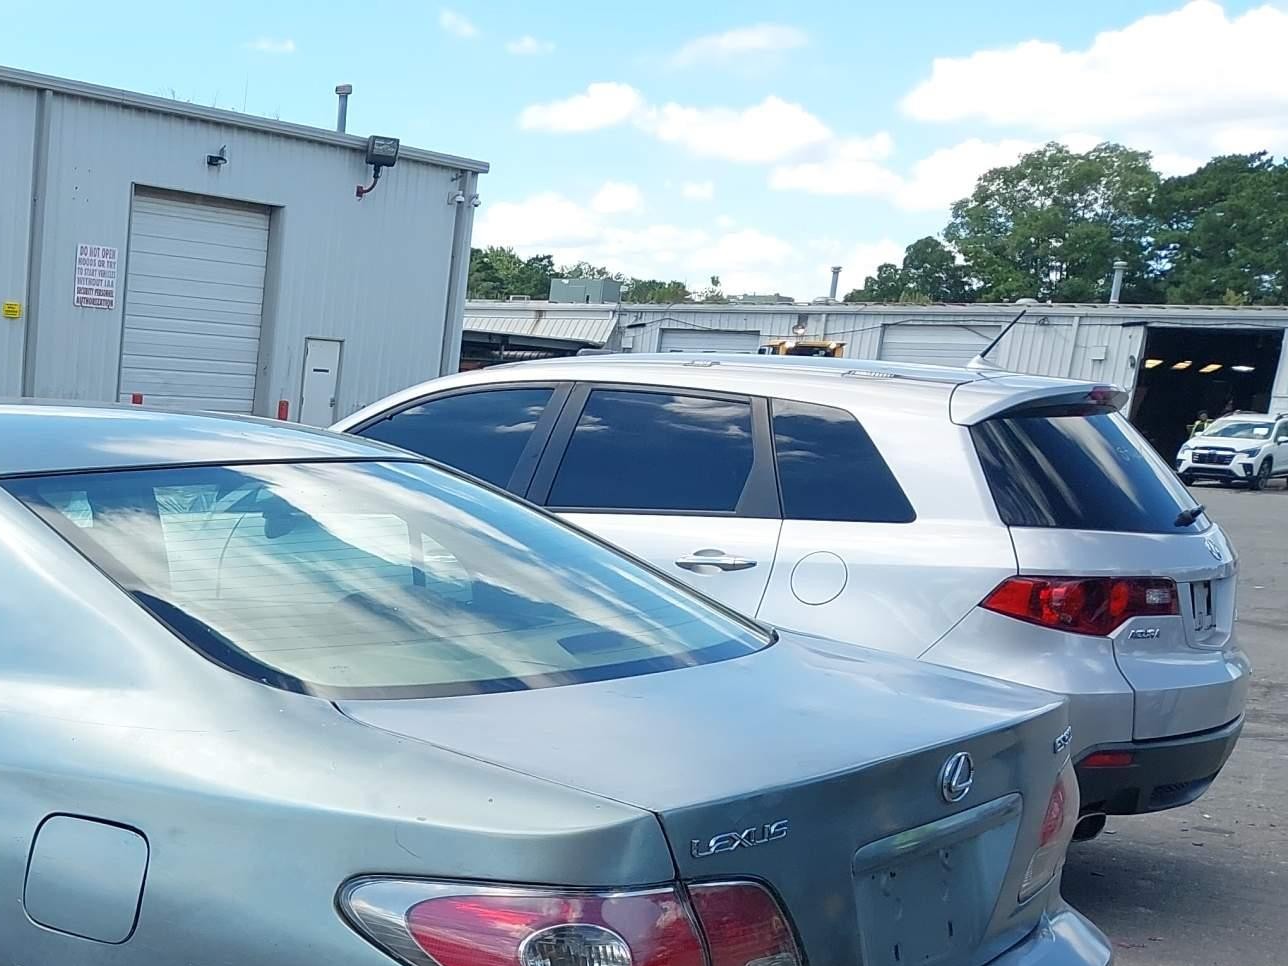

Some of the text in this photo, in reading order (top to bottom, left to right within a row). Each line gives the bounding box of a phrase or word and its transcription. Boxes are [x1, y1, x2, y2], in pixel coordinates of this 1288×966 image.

[80, 246, 116, 259] DO NOT OPEN
[78, 257, 117, 270] HOODS OR TRY
[78, 267, 83, 276] TO
[77, 277, 103, 287] WITHOUT
[691, 819, 789, 858] LEXUS
